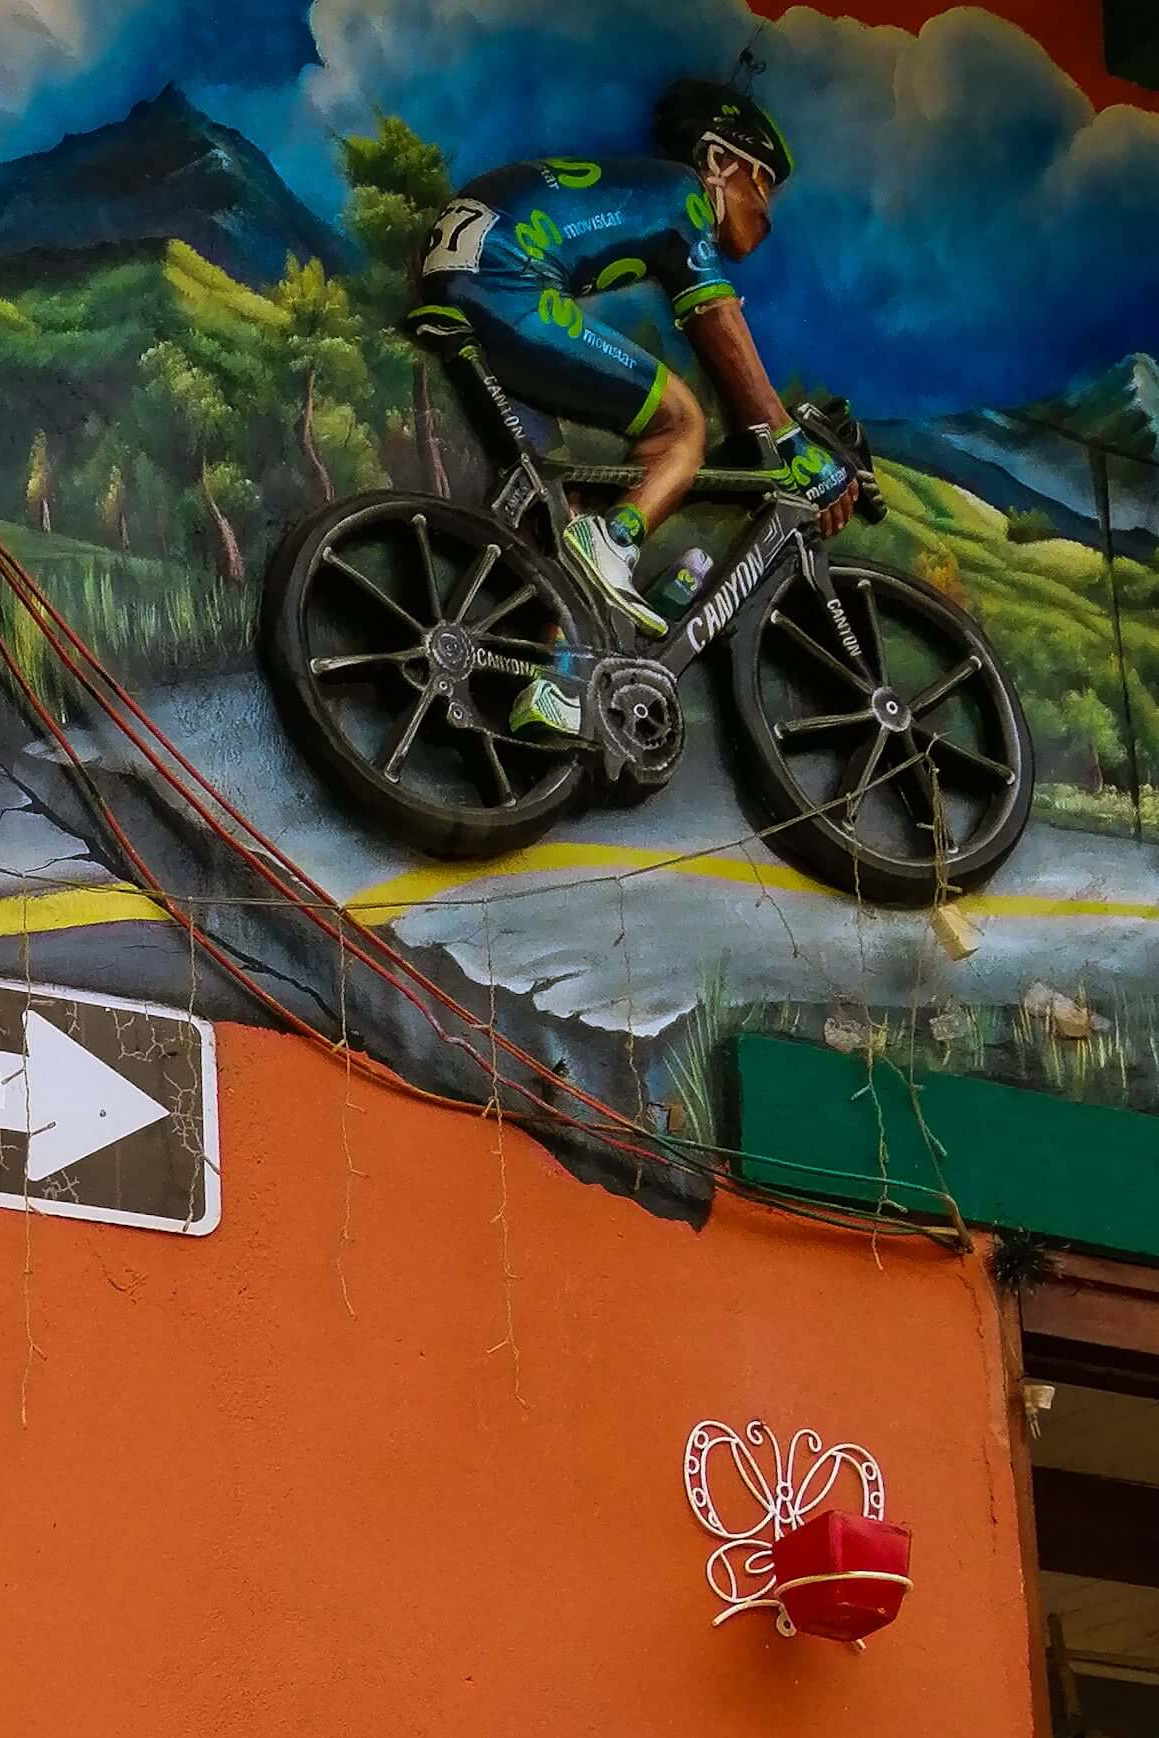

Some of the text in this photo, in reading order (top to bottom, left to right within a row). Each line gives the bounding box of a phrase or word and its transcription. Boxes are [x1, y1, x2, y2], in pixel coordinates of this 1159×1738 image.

[562, 209, 623, 240] movistar
[582, 328, 638, 370] movistar
[805, 465, 848, 501] movistar
[686, 543, 765, 655] CANYON
[477, 647, 529, 675] CANYON
